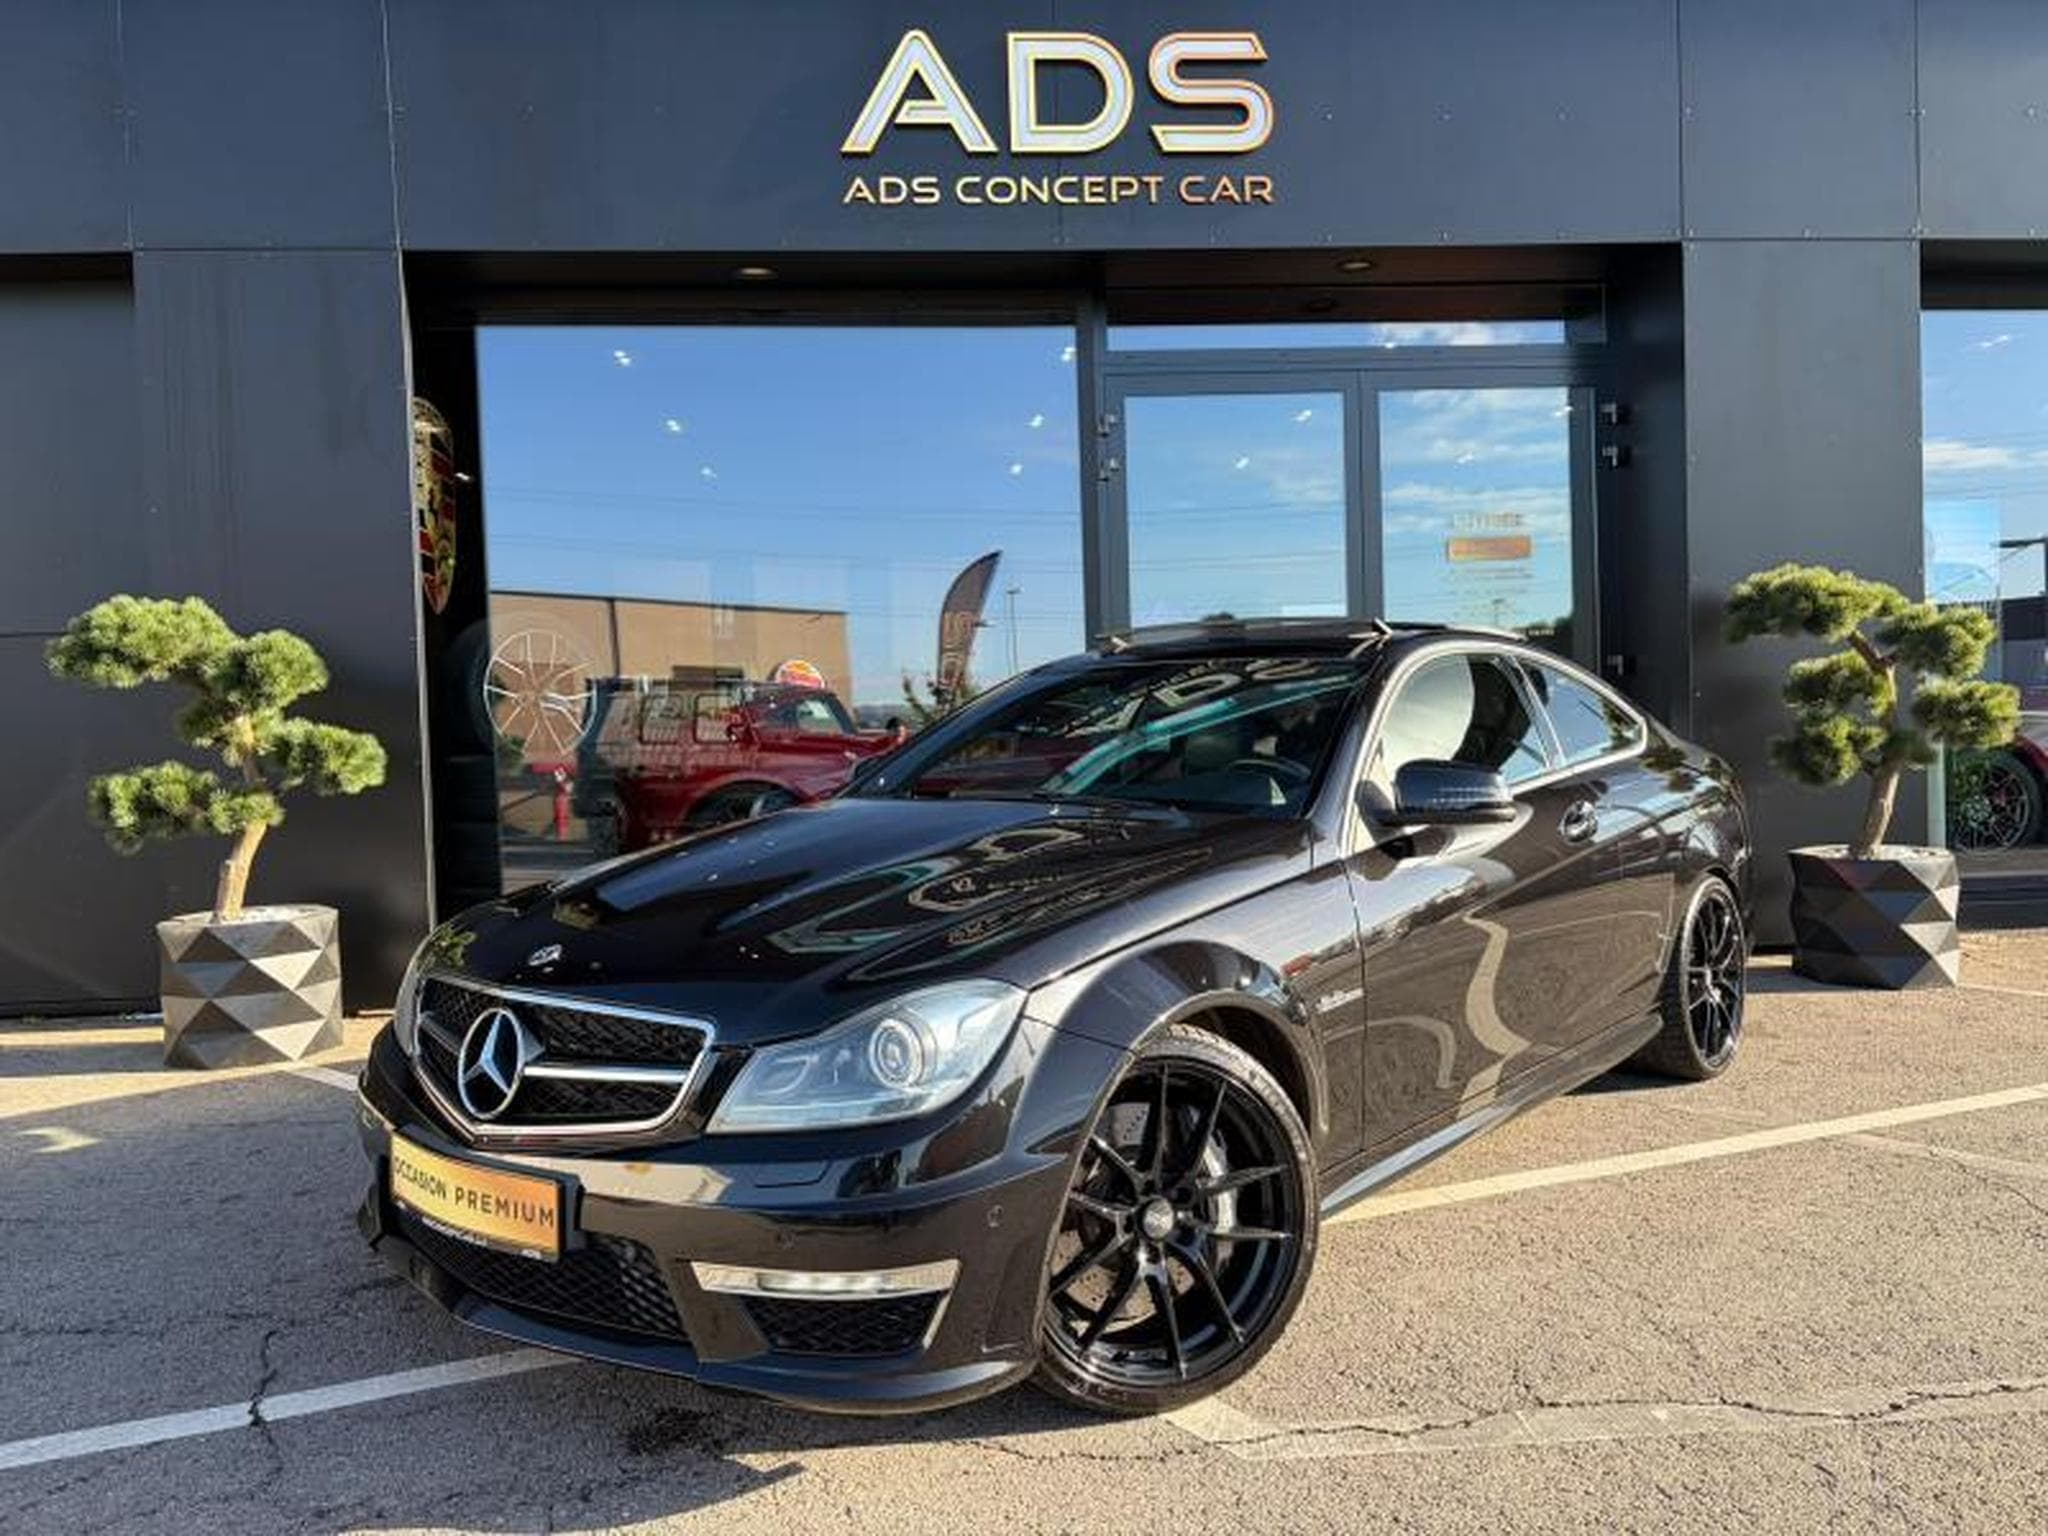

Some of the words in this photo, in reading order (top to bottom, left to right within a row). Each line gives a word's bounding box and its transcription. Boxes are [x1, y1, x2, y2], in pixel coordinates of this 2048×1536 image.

[840, 28, 1275, 154] ADS
[842, 175, 941, 205] ADS
[954, 175, 1165, 205] CONCEPT
[1178, 175, 1275, 205] CAR
[454, 1186, 555, 1229] PREMIUM
